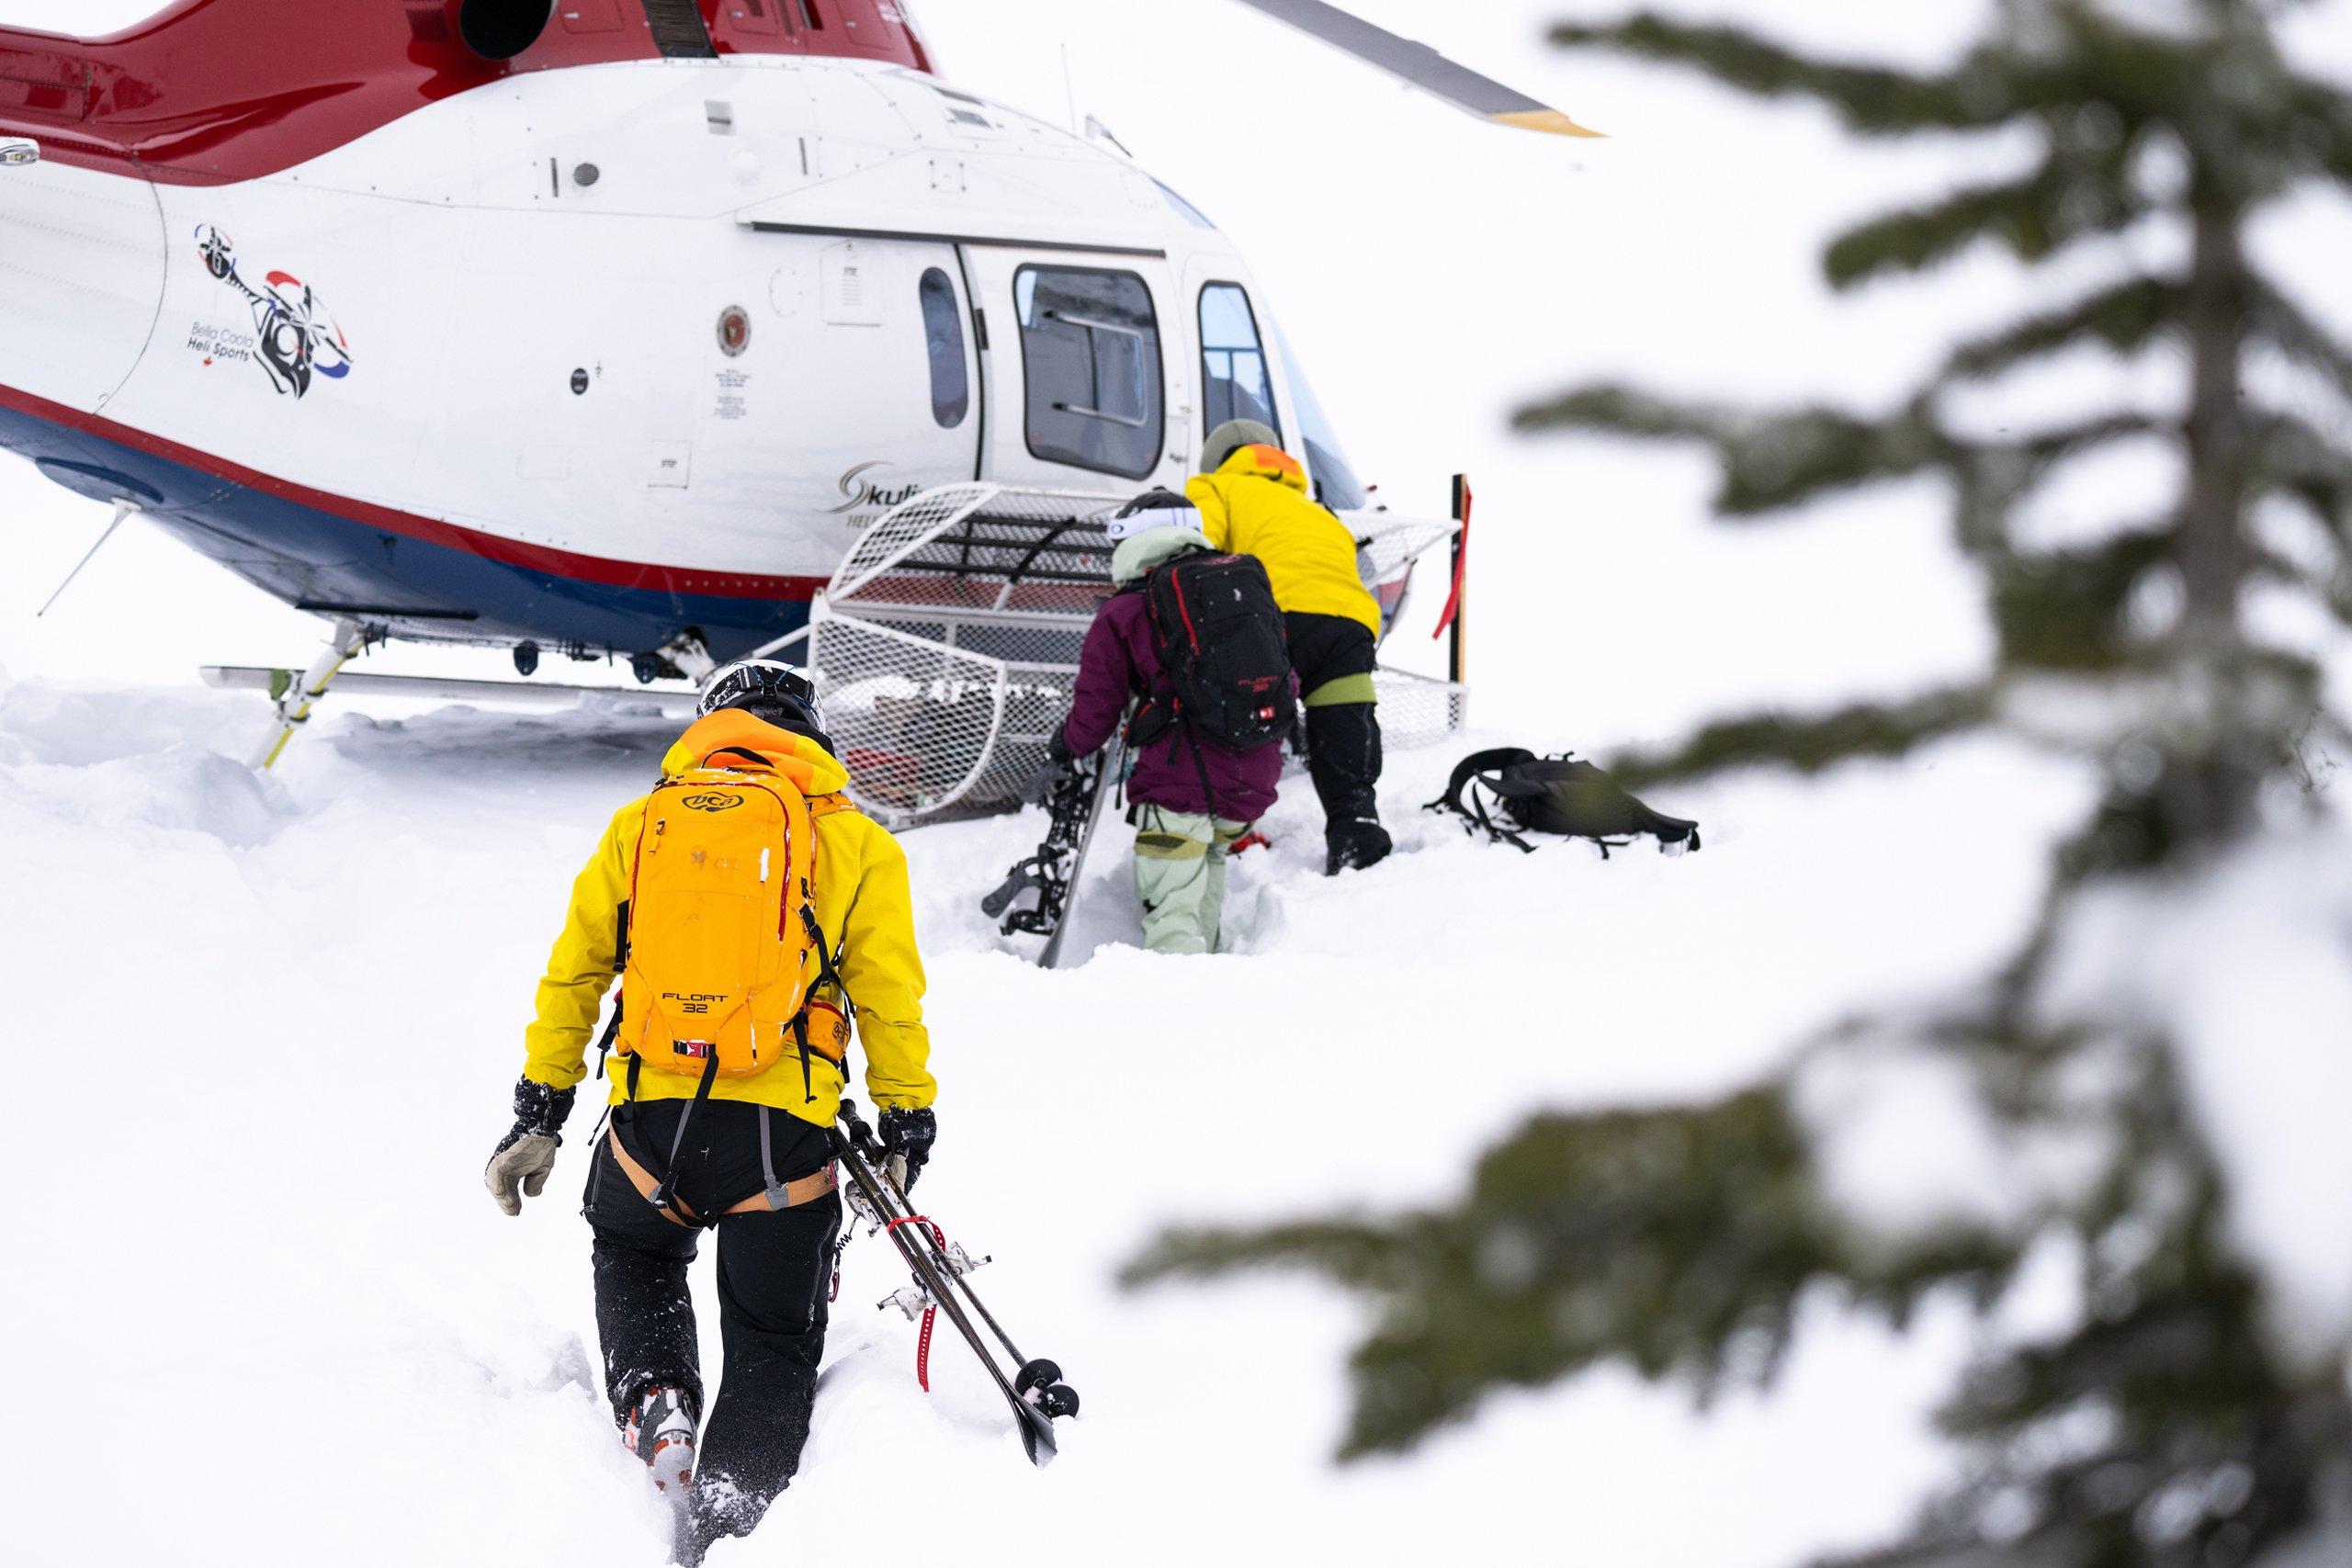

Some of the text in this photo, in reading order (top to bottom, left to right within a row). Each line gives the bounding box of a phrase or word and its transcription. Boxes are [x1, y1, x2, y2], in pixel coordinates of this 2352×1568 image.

[191, 321, 254, 348] Bella Coola
[187, 336, 249, 362] Heli Sports
[662, 992, 729, 1003] FLOAT
[682, 1002, 708, 1014] 32
